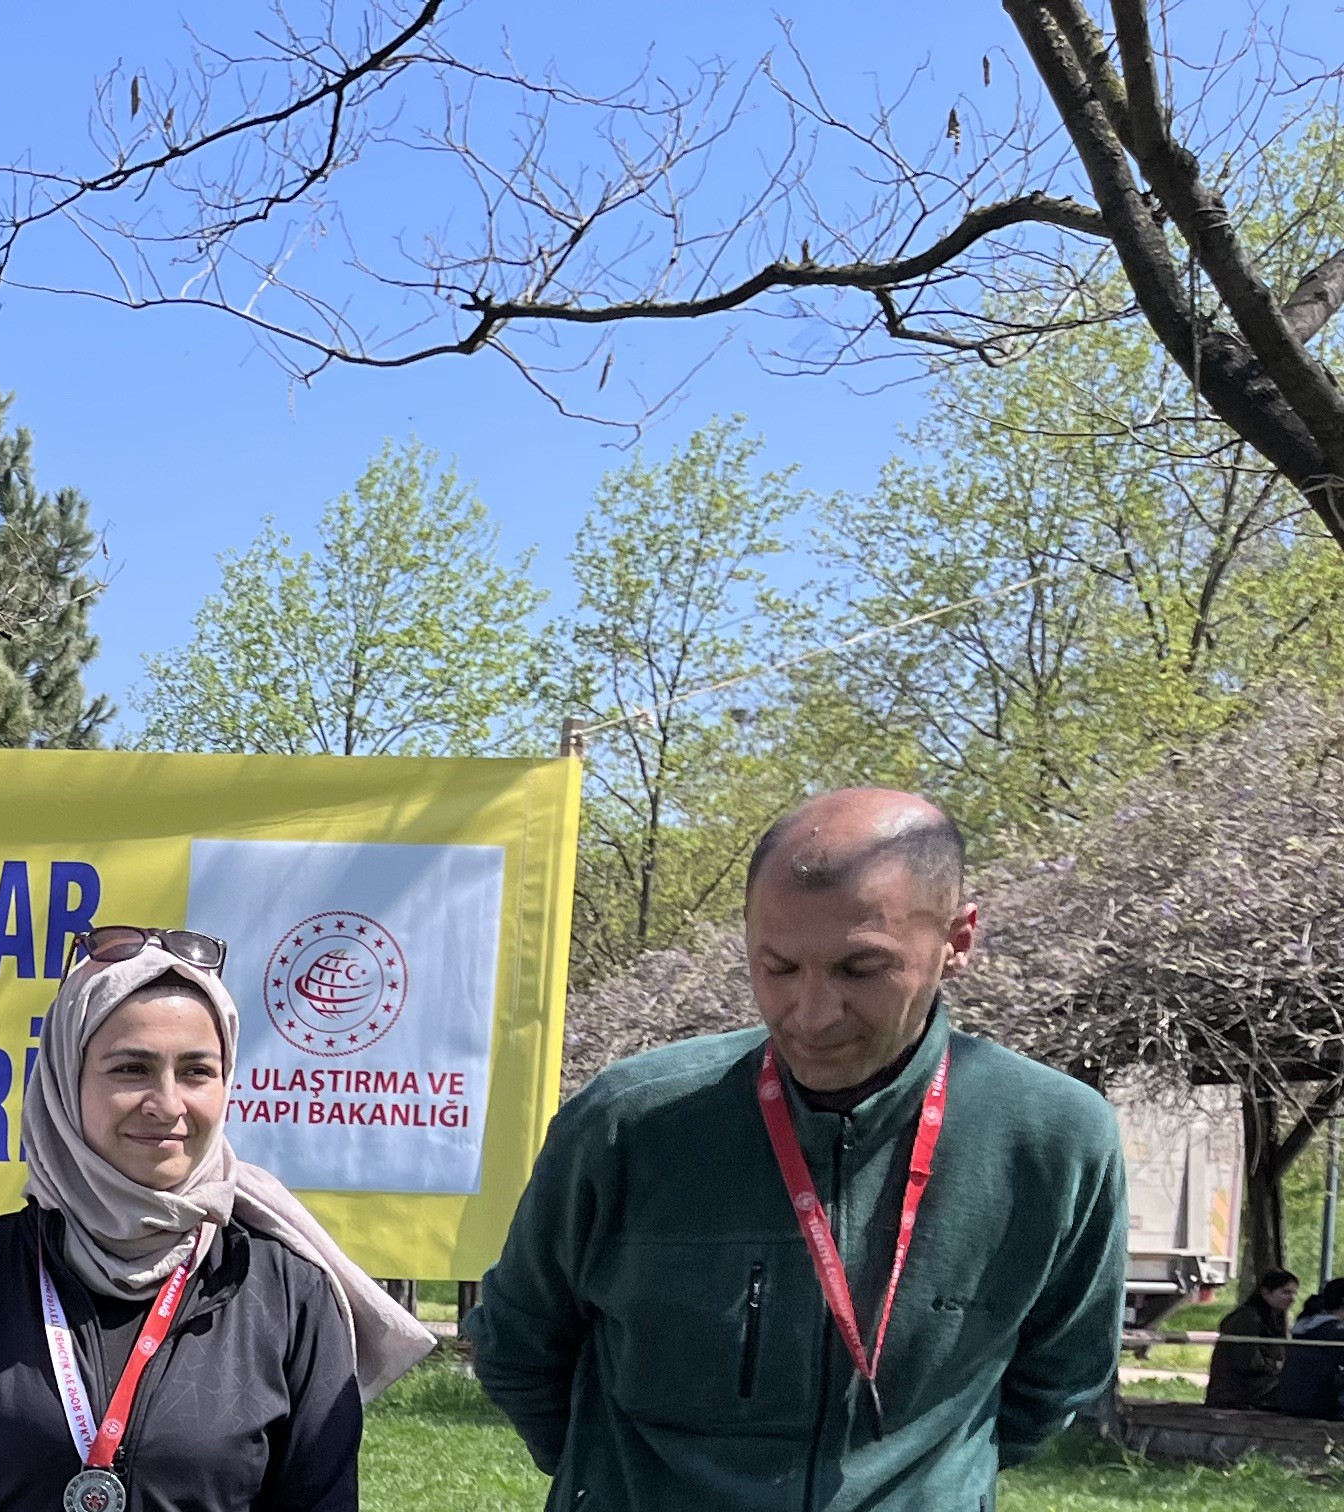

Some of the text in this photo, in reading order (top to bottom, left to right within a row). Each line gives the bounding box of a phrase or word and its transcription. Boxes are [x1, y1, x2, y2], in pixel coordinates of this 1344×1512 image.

[251, 1067, 466, 1099] ULAŞTIRMA VE
[223, 1099, 470, 1129] TYAPI BAKANLIĞI
